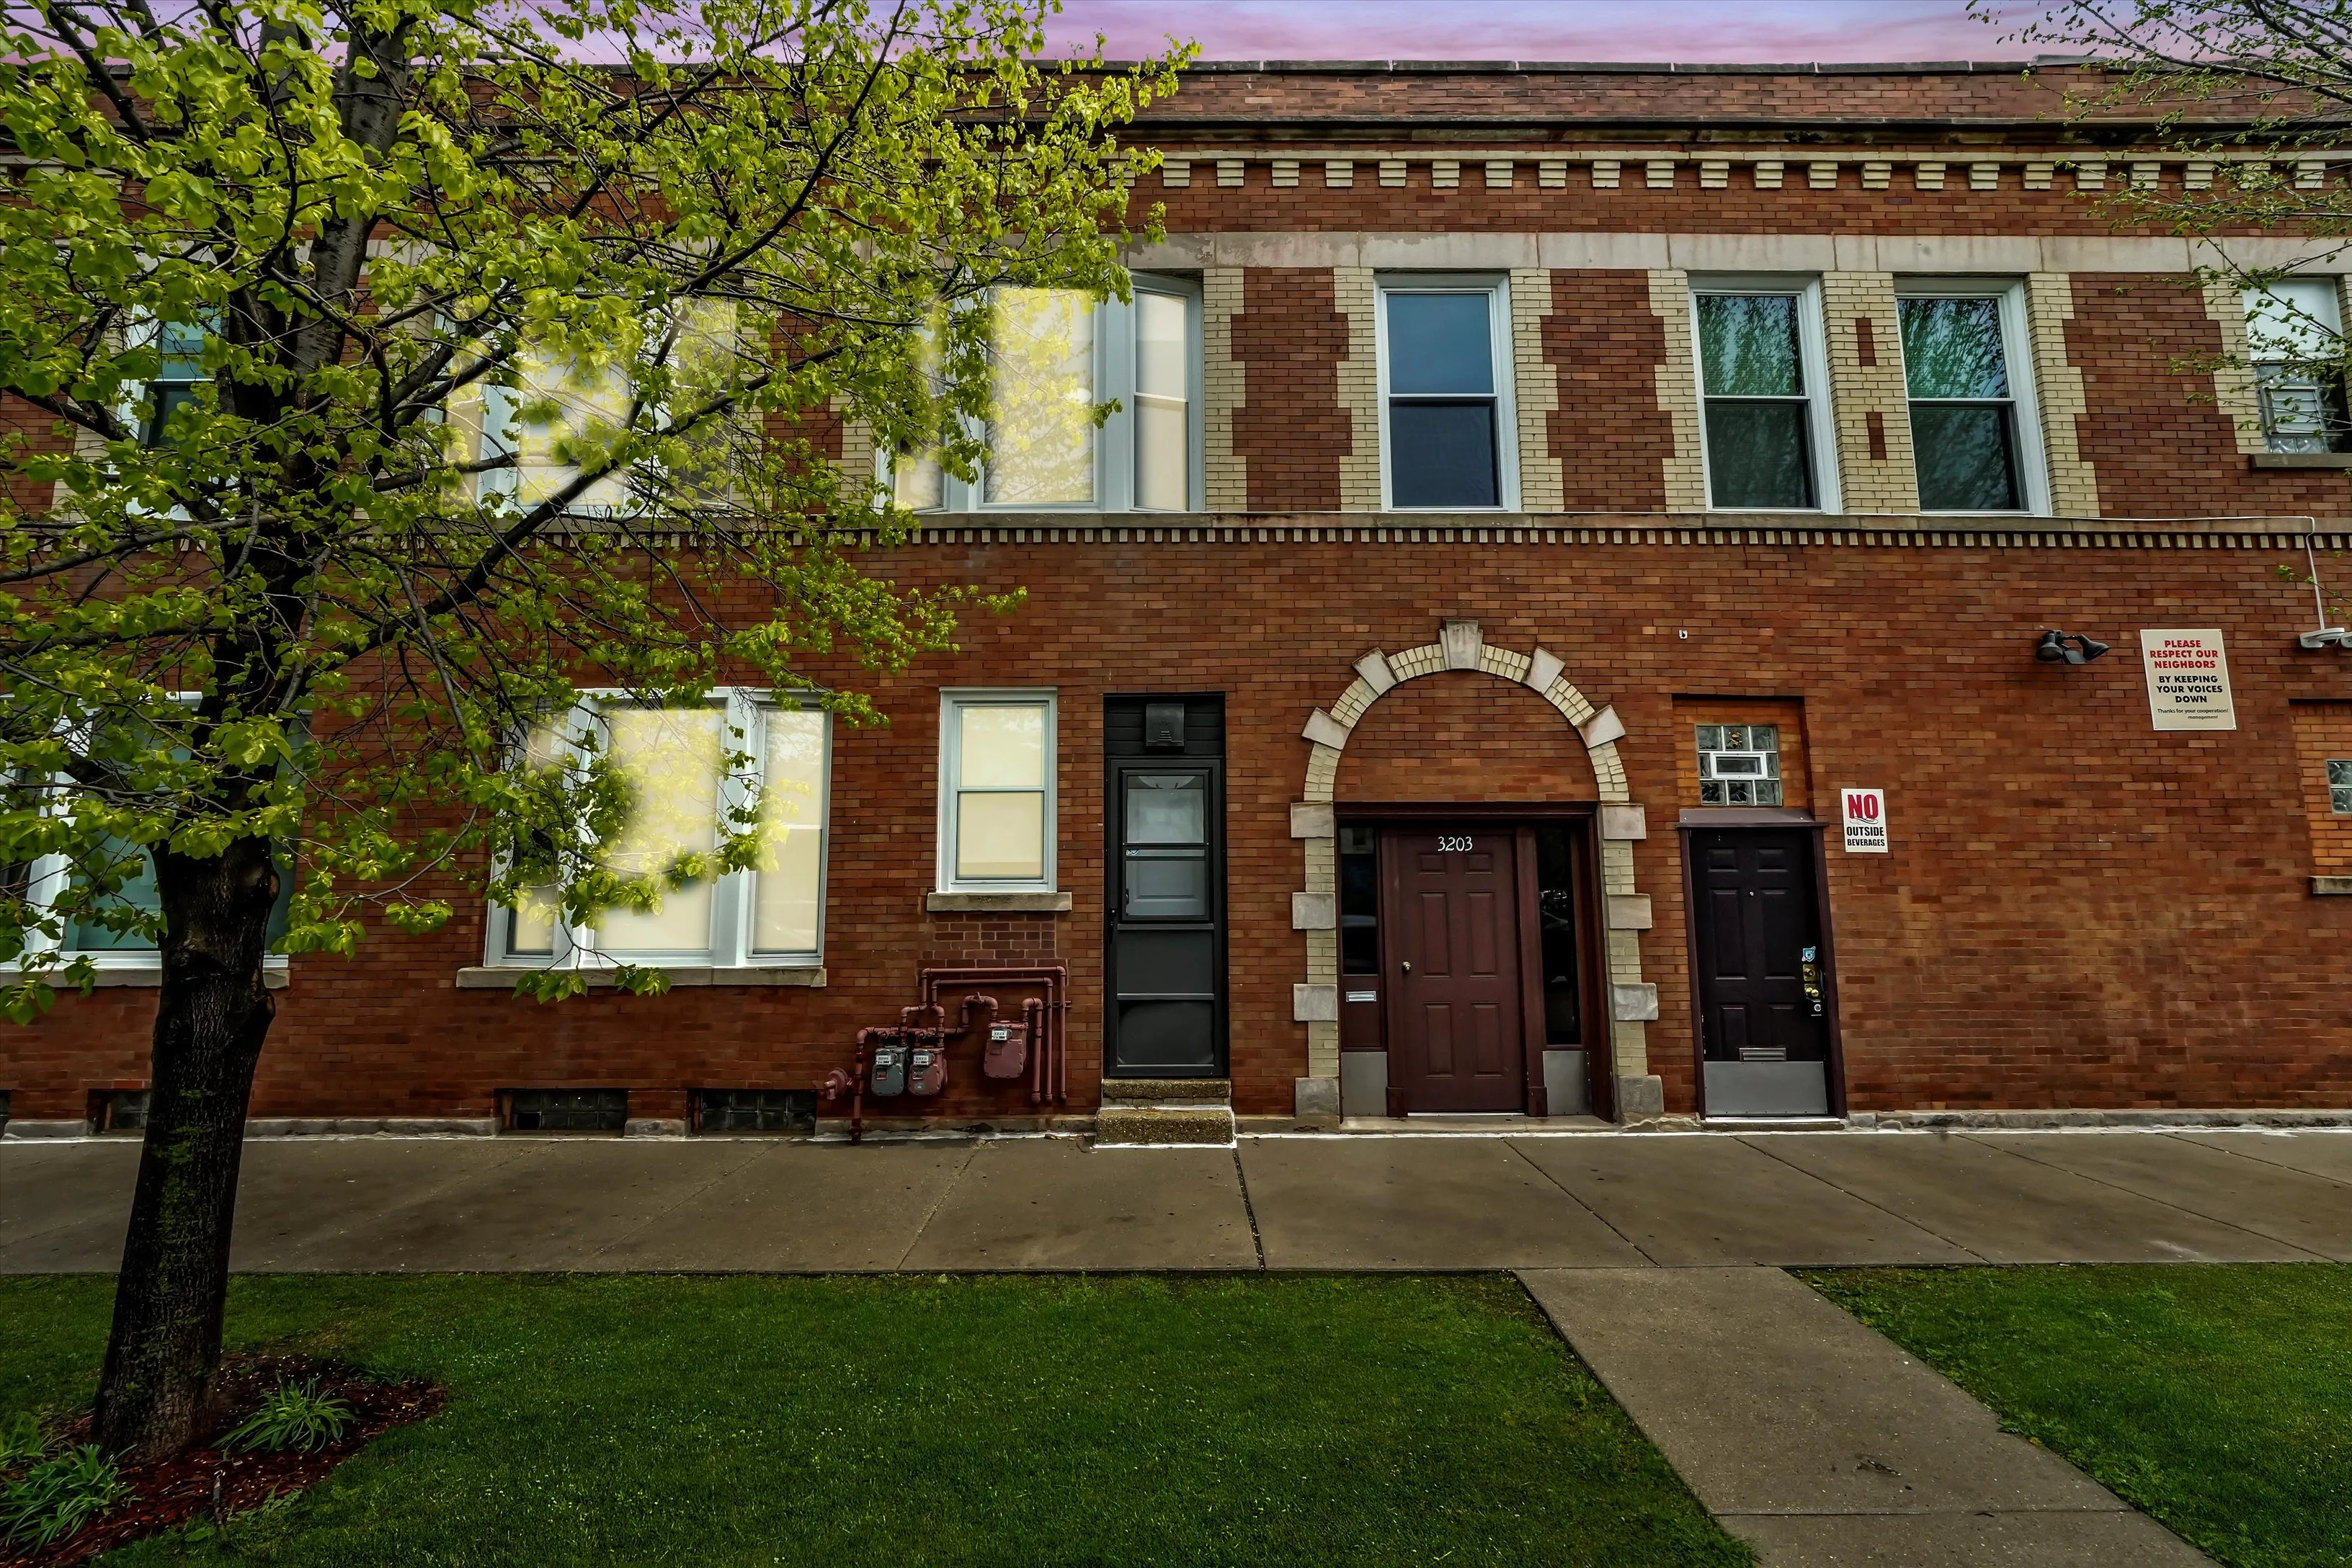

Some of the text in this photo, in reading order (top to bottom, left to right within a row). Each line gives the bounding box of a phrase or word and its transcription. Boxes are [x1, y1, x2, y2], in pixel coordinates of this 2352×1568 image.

[1848, 794, 1878, 819] NO
[1847, 827, 1884, 836] OUTSIDE
[1438, 837, 1473, 851] 3203
